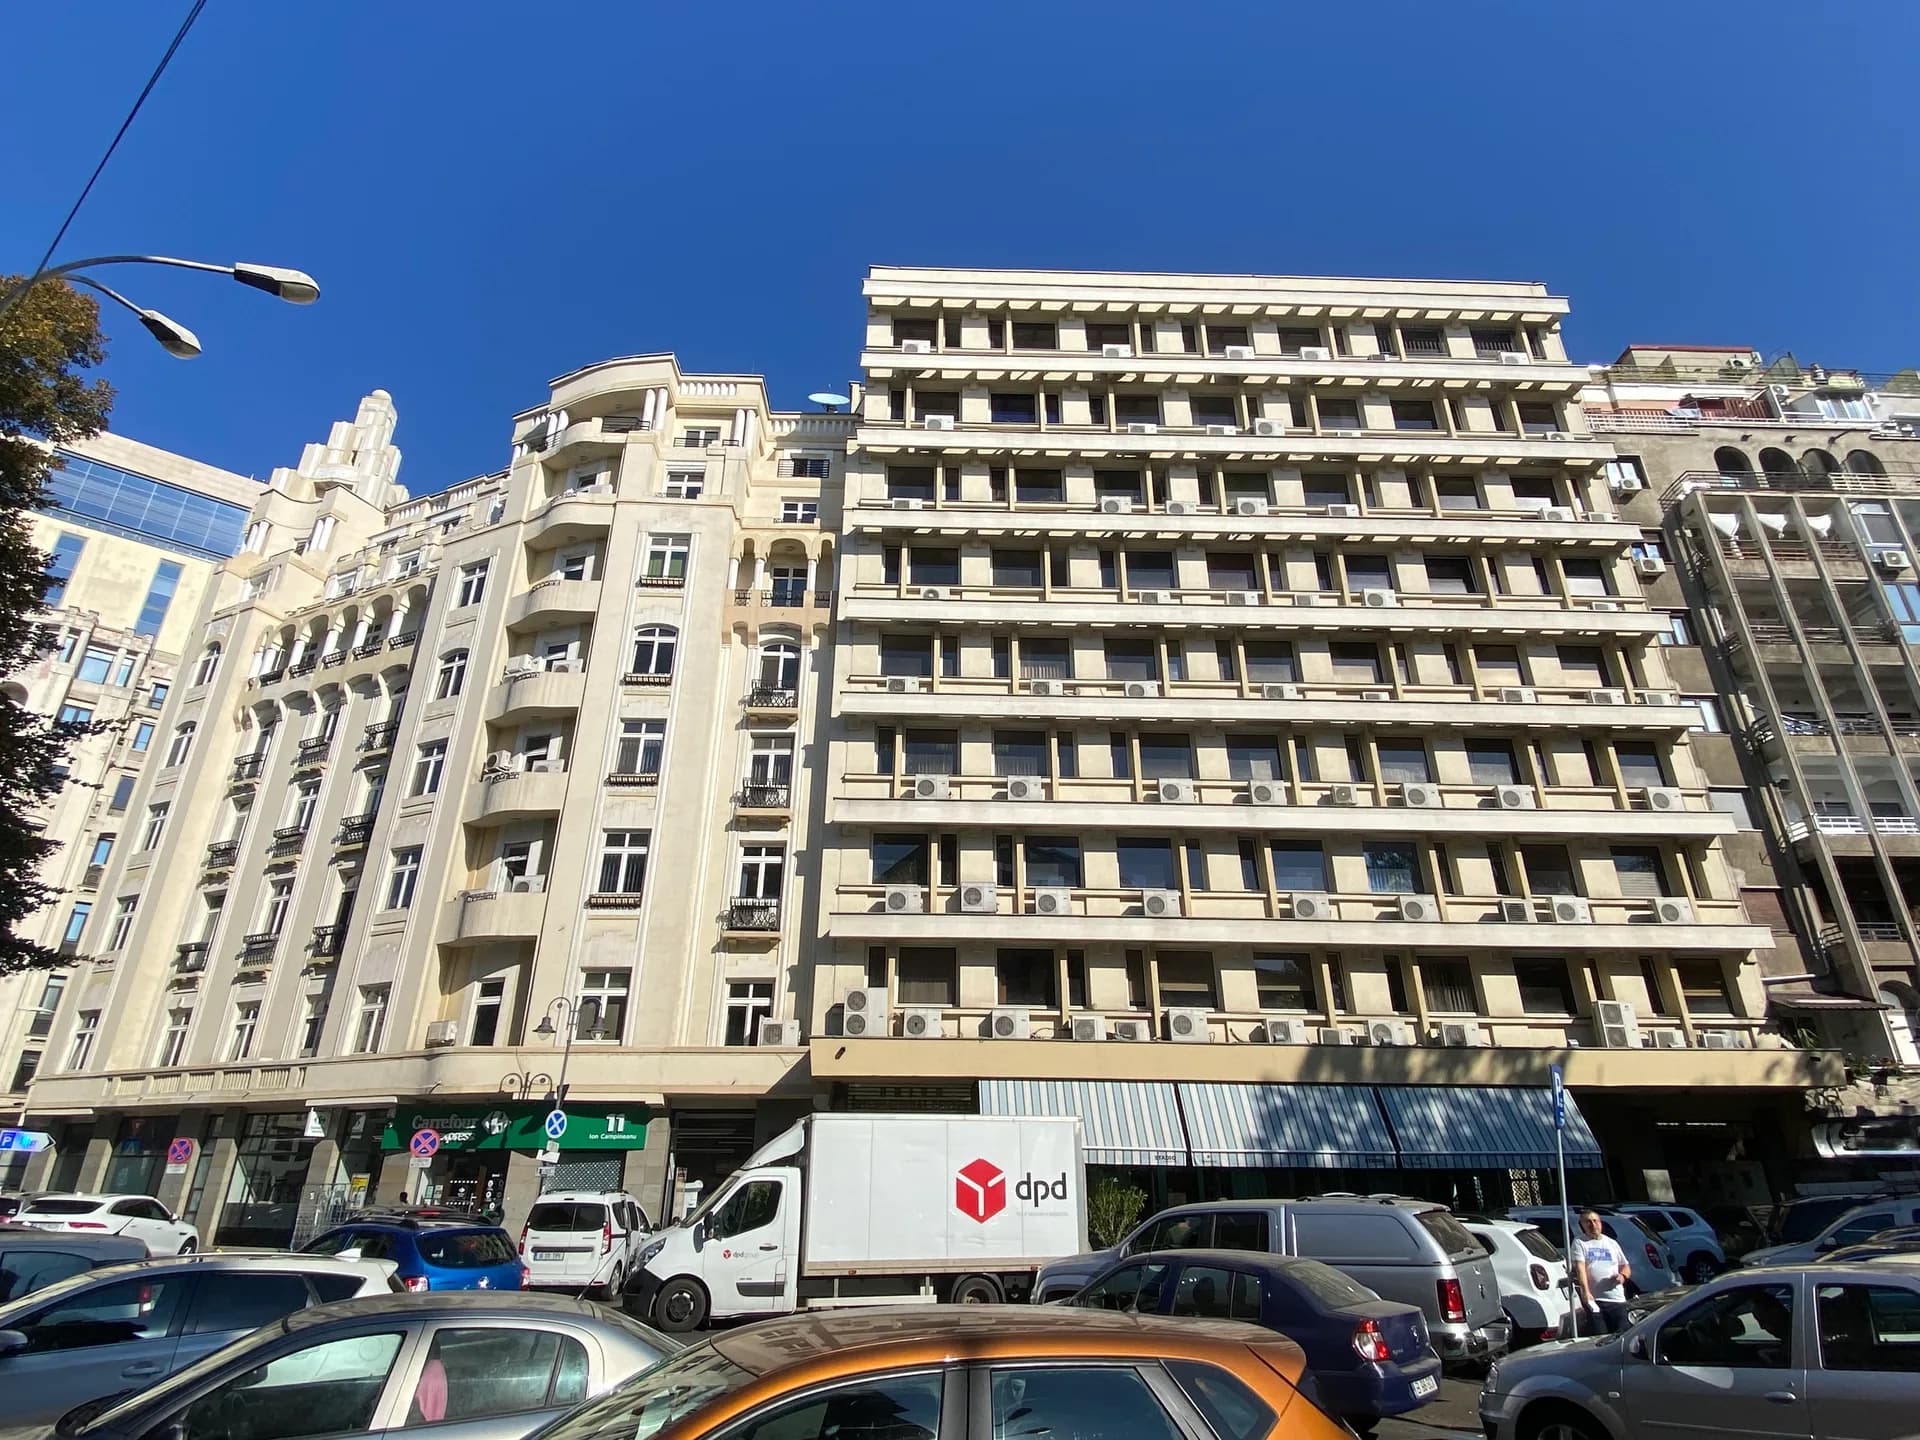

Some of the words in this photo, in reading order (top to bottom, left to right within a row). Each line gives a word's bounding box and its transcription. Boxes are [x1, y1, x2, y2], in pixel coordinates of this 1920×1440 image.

[412, 1114, 479, 1129] Carrefour
[606, 1114, 625, 1132] 11
[1, 1136, 12, 1147] P
[1015, 1172, 1068, 1208] dpd
